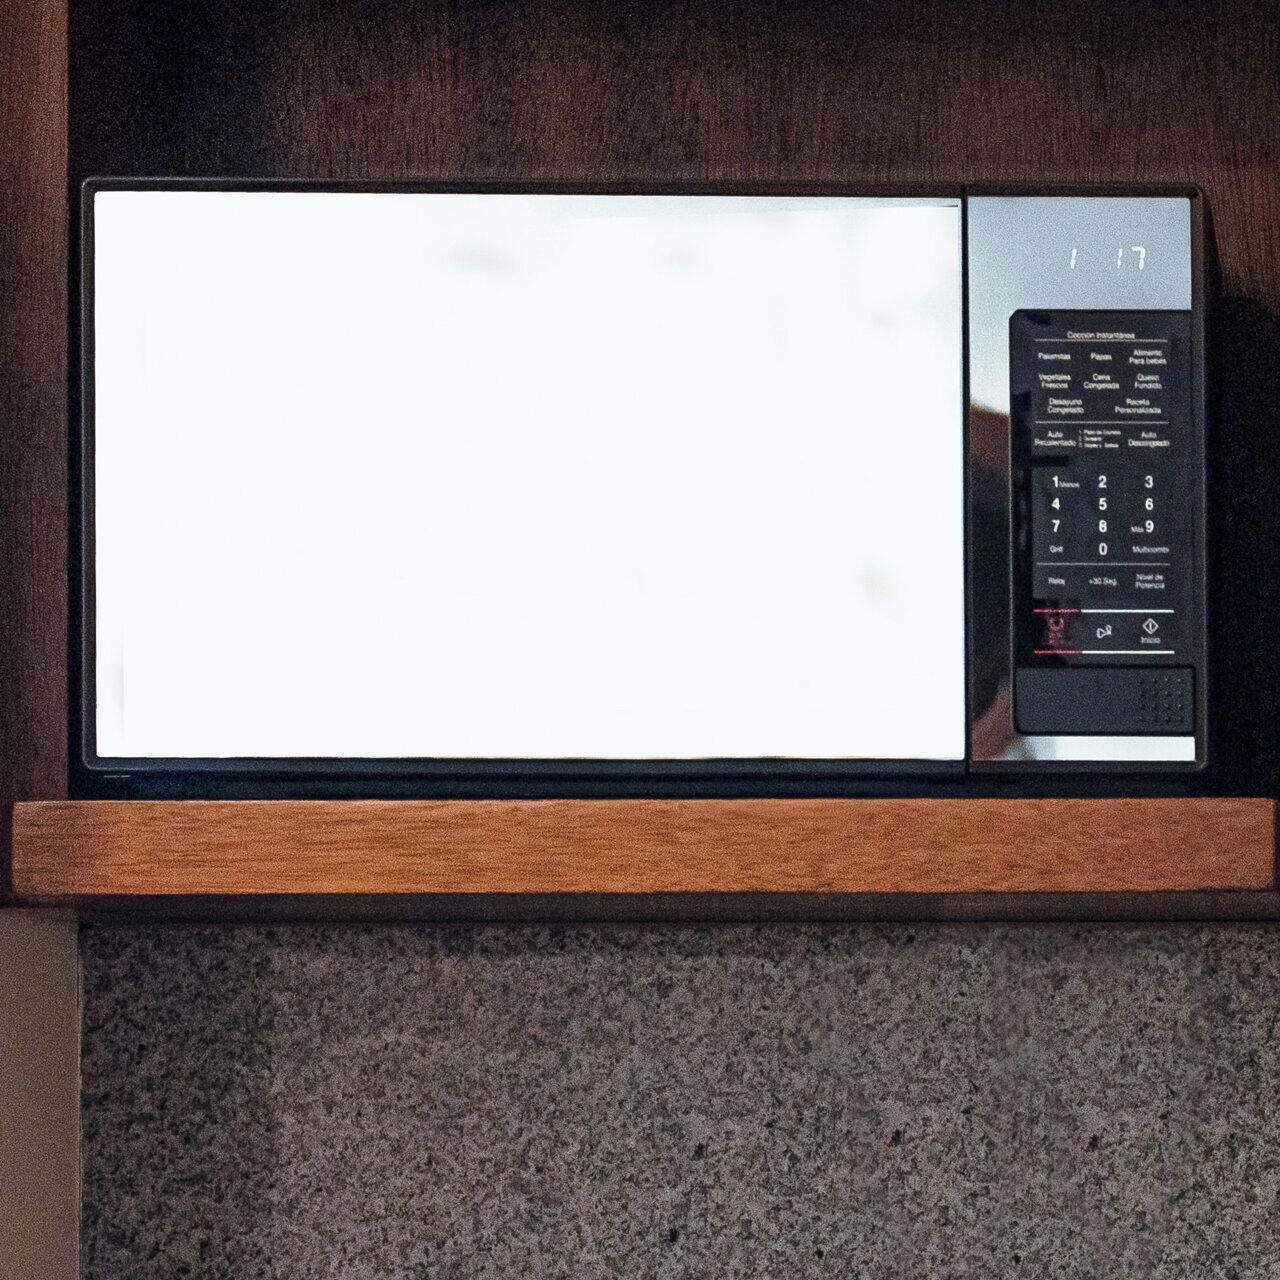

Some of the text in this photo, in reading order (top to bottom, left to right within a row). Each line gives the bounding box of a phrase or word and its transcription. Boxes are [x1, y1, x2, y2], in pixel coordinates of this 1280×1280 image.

[1052, 475, 1059, 488] 1
[1098, 475, 1107, 488] 2
[1144, 475, 1154, 489] 3
[1051, 497, 1060, 510] 4
[1098, 497, 1107, 510] 5
[1145, 498, 1154, 511] 6
[1052, 519, 1060, 532] 7
[1098, 519, 1108, 533] 8
[1145, 519, 1154, 533] 9
[1098, 542, 1108, 556] 0
